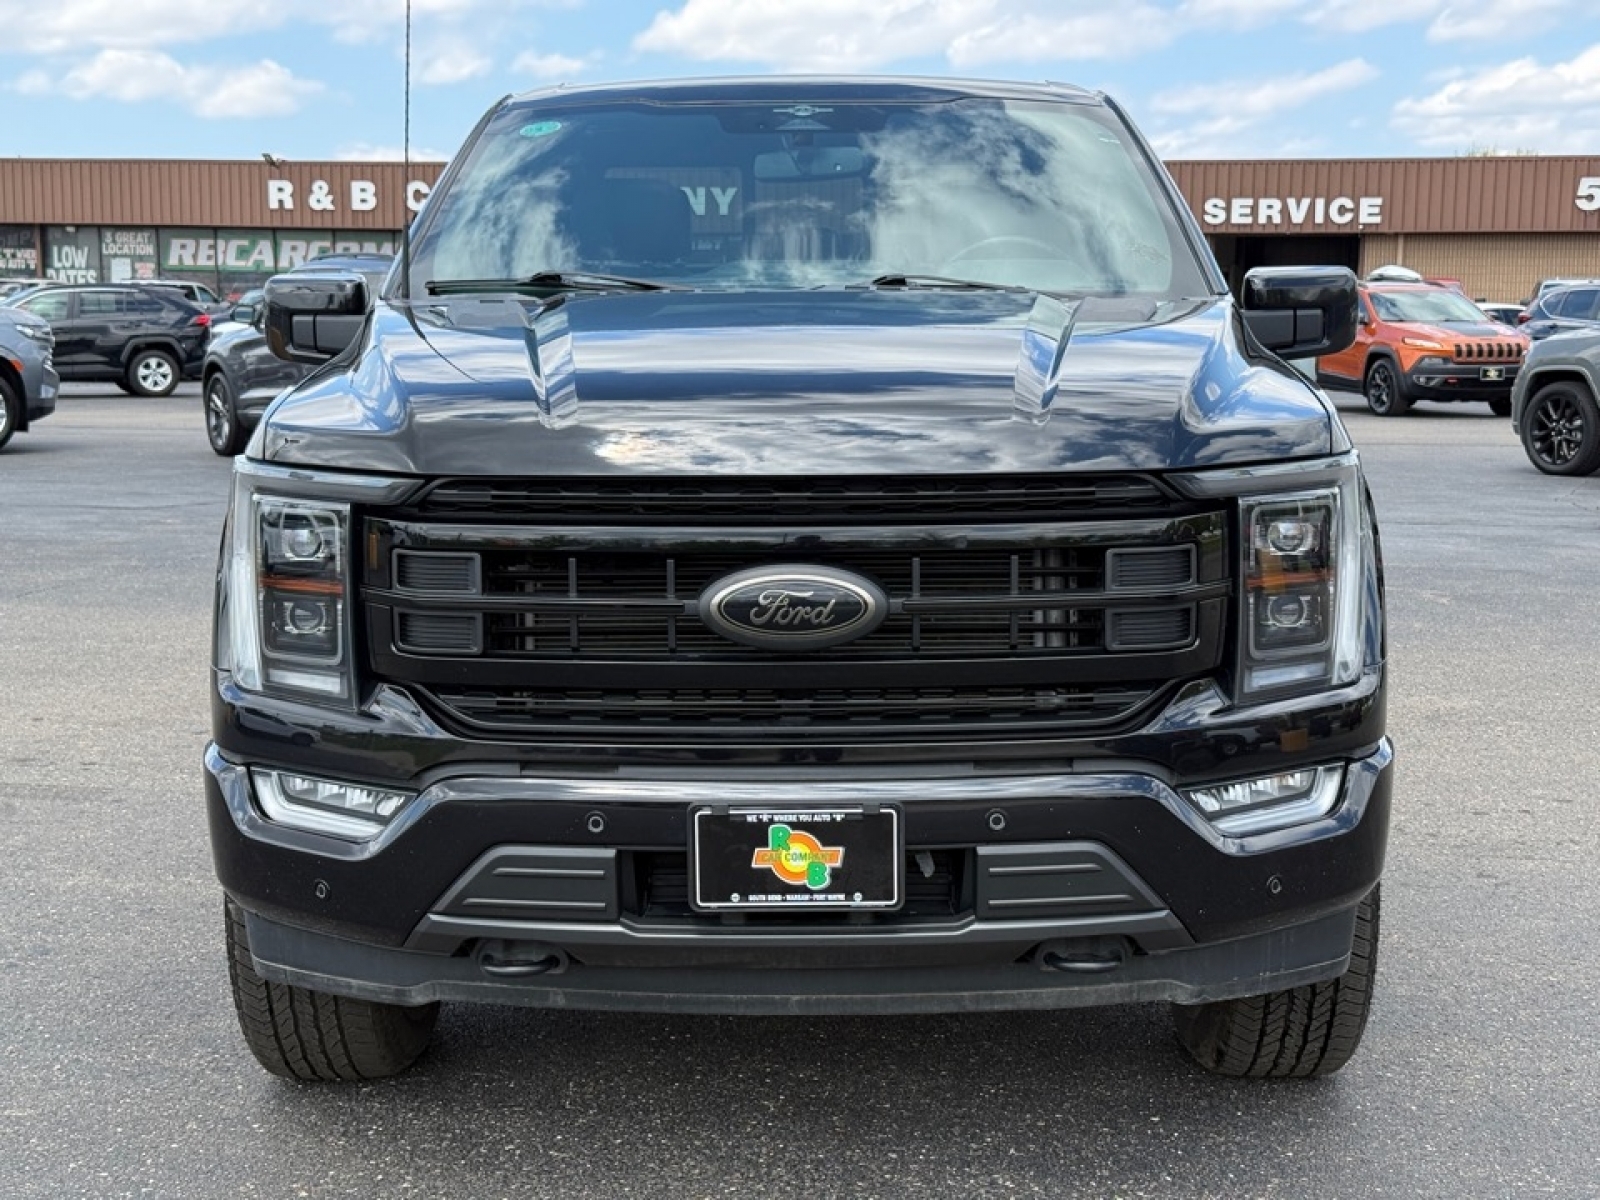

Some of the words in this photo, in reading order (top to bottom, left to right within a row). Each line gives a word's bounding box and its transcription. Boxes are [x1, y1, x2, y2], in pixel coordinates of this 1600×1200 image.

[268, 180, 294, 210] R
[309, 180, 335, 210] &
[351, 181, 377, 210] B
[1203, 197, 1383, 225] SERVICE
[114, 231, 151, 244] GREAT
[52, 246, 89, 268] LOW
[750, 590, 836, 626] Ford
[769, 824, 792, 851] R
[807, 861, 831, 889] B
